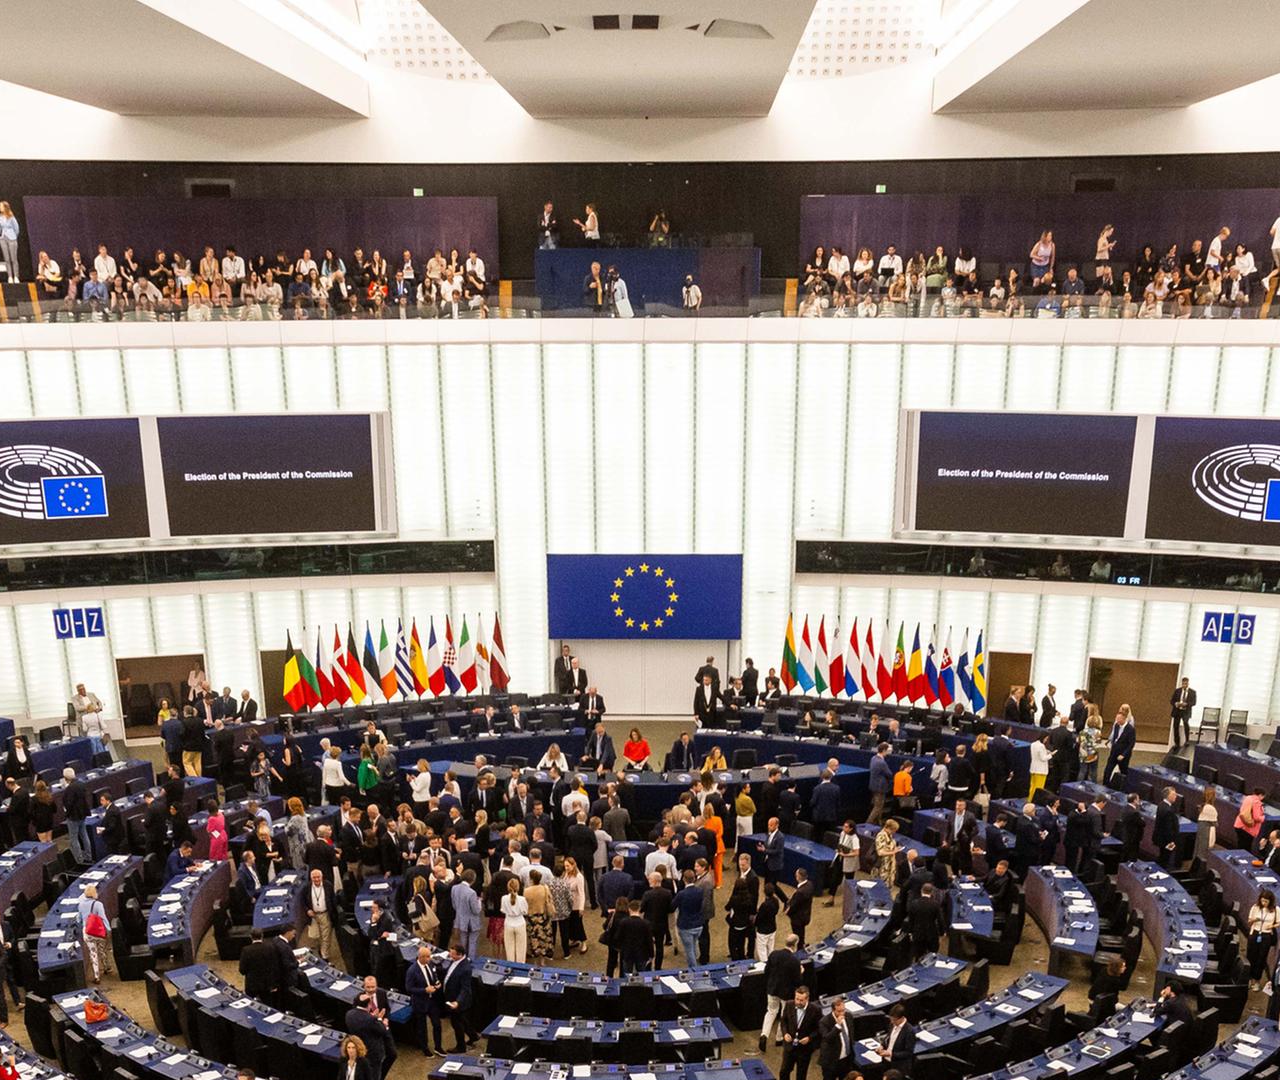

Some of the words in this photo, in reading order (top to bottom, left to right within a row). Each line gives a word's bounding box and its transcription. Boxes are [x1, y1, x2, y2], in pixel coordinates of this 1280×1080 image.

[184, 472, 217, 482] Election
[218, 472, 227, 481] of
[228, 472, 241, 480] the
[242, 471, 280, 480] President
[281, 470, 290, 480] of
[291, 471, 304, 480] the
[305, 470, 353, 479] Commission
[937, 468, 970, 477] Election
[971, 469, 980, 478] of
[981, 469, 994, 478] the
[995, 469, 1033, 479] President
[1034, 470, 1044, 480] of
[1044, 471, 1058, 480] the
[1058, 471, 1109, 481] Commission
[1116, 576, 1127, 585] 03
[1129, 576, 1141, 585] FR
[56, 612, 101, 634] U-Z
[1203, 617, 1252, 640] A-B
